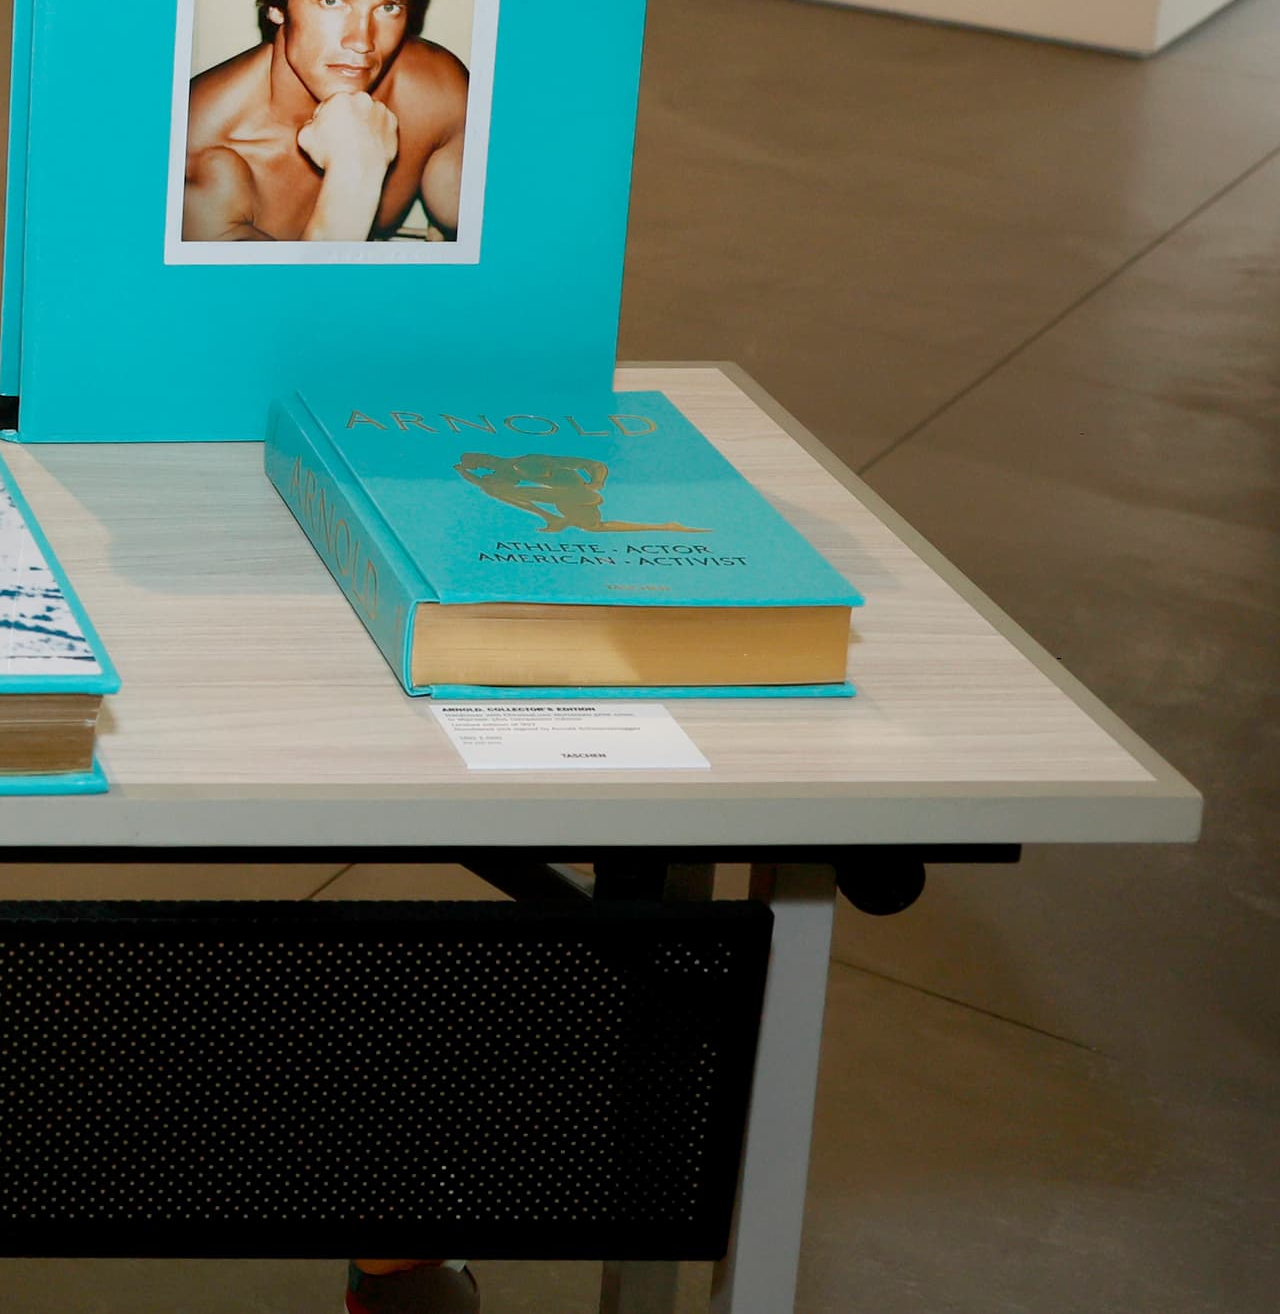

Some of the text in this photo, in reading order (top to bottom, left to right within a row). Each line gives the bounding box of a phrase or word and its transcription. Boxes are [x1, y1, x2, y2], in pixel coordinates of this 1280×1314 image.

[344, 410, 658, 438] ARNOLD
[288, 453, 379, 620] ARNOLD
[495, 541, 711, 555] ATHLETE ACTOR
[477, 552, 748, 567] AMERICAN ACTIVIST
